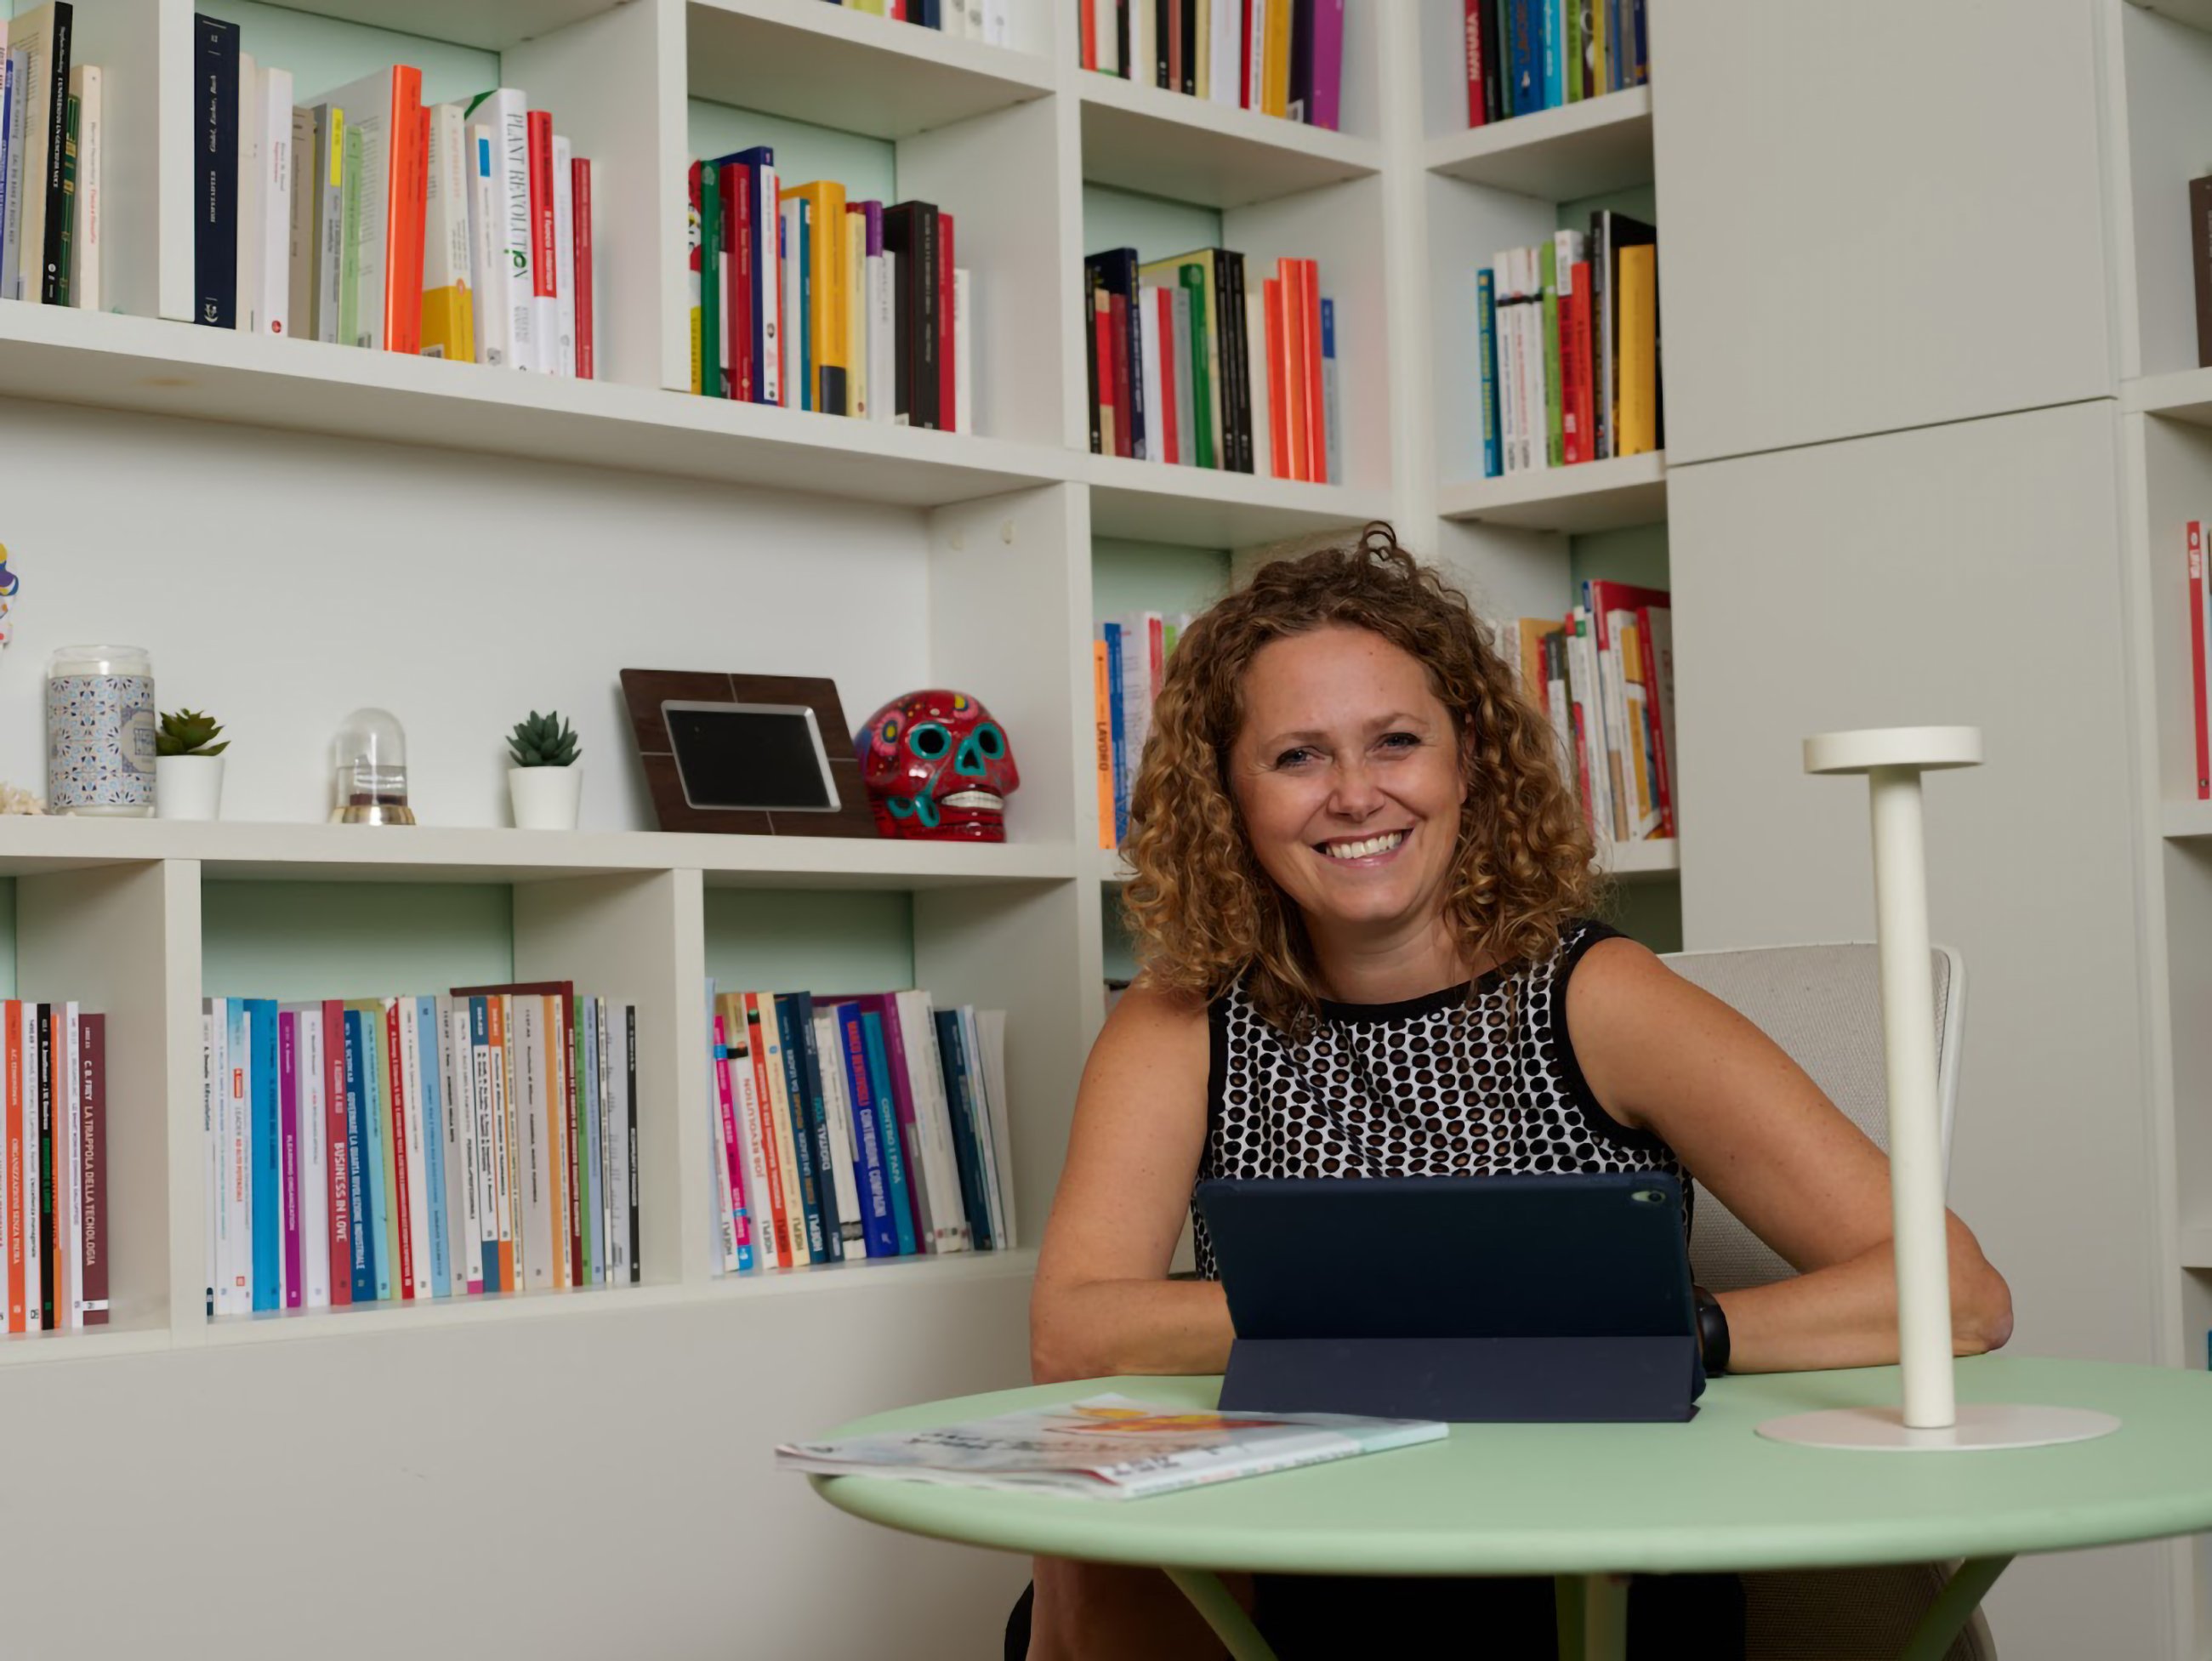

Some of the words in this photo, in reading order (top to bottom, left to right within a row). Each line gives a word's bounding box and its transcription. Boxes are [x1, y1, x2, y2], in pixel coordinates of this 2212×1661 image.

[506, 114, 525, 164] PLANT
[1097, 722, 1109, 771] LAVORO
[787, 1049, 797, 1078] LEADER
[85, 1106, 92, 1118] LA
[347, 1092, 357, 1134] GOVERNARE
[743, 1078, 760, 1154] REVOLUTION
[814, 1097, 824, 1122] YOU
[847, 1021, 861, 1053] MARCO
[869, 1170, 887, 1217] COMPAGNI
[881, 1098, 895, 1145] CONTRO
[85, 1120, 94, 1169] TRAPPOLA
[350, 1136, 358, 1145] LA
[817, 1123, 831, 1170] DIGITAL
[335, 1143, 346, 1198] BUSINESS
[753, 1157, 765, 1177] JOB
[85, 1172, 94, 1203] DELLA
[336, 1200, 346, 1212] IN
[85, 1205, 95, 1266] TECNOLOGIA
[336, 1214, 347, 1242] LOVE
[762, 1220, 773, 1254] HOEPLI
[793, 1218, 803, 1251] HOEPLI
[809, 1214, 823, 1251] HOEPLI
